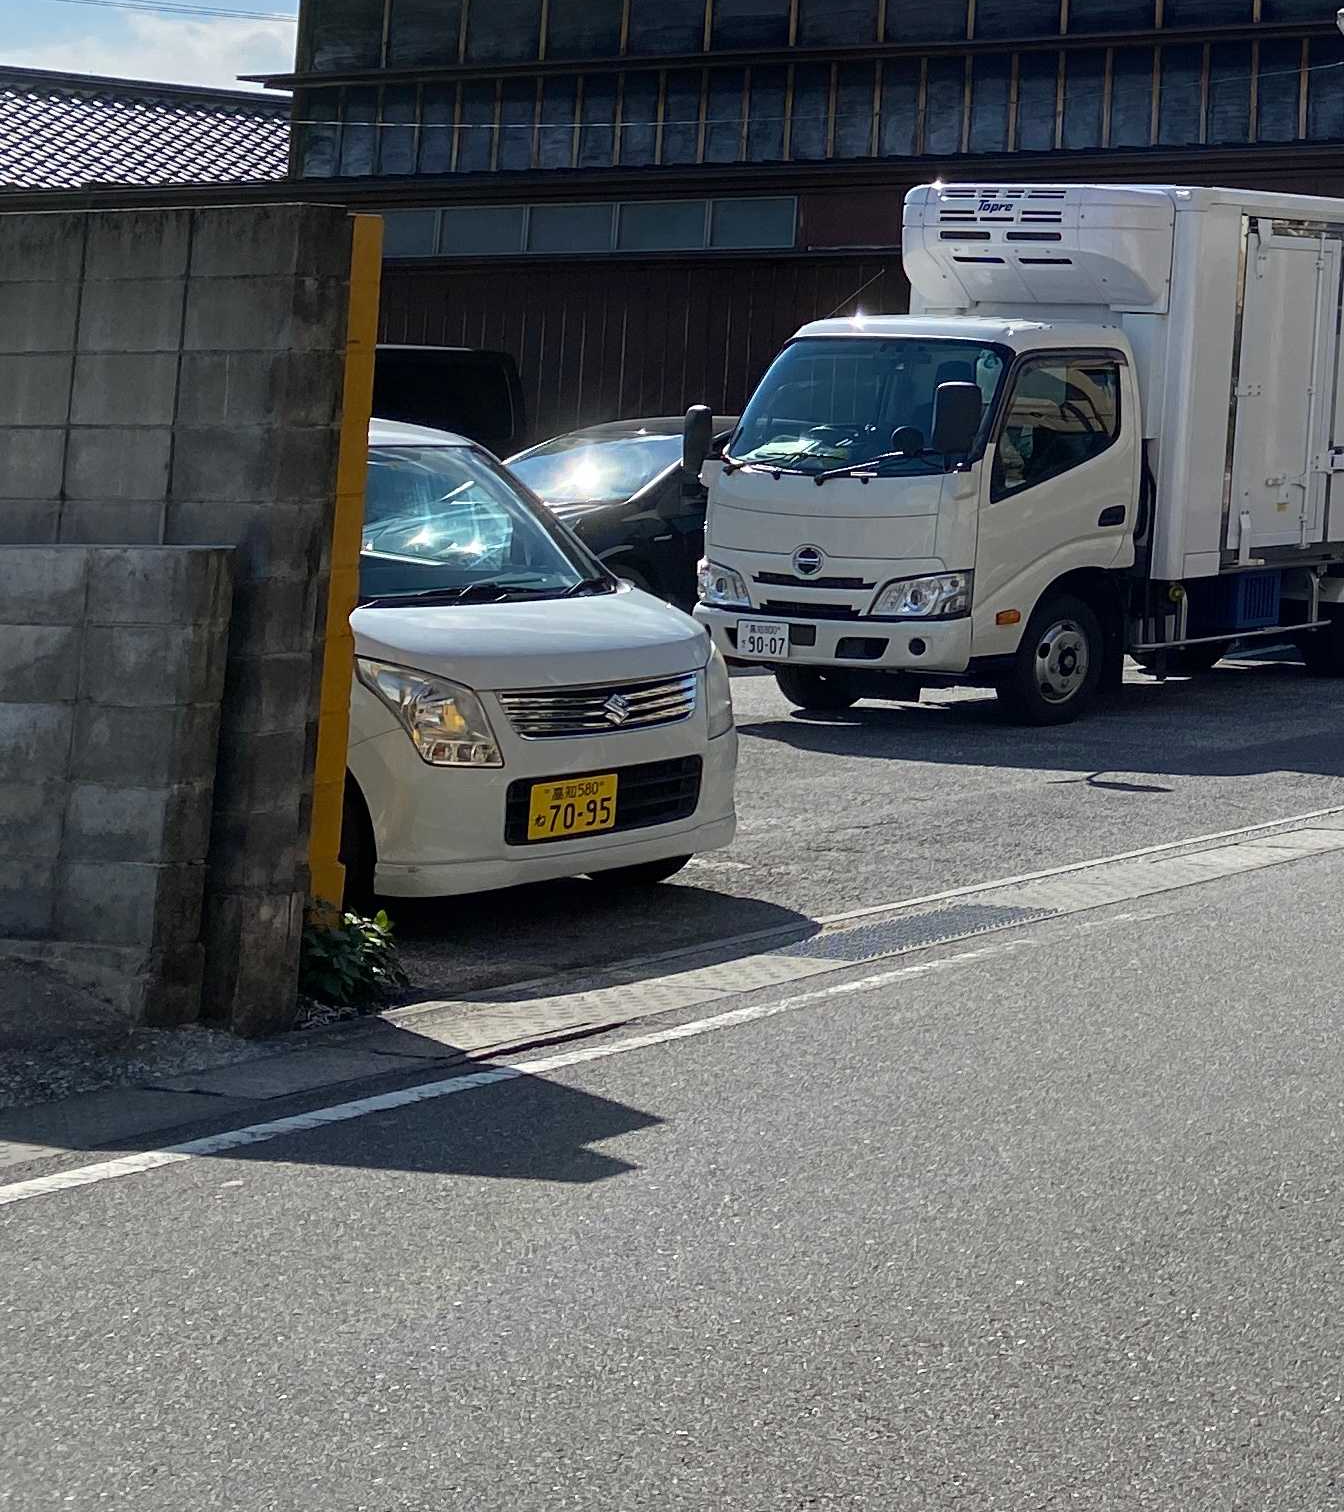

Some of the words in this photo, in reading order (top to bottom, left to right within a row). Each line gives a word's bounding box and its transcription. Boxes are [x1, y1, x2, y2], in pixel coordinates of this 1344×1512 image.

[978, 199, 1014, 214] Topre
[749, 635, 786, 656] 90-07
[549, 796, 613, 833] 70-95
